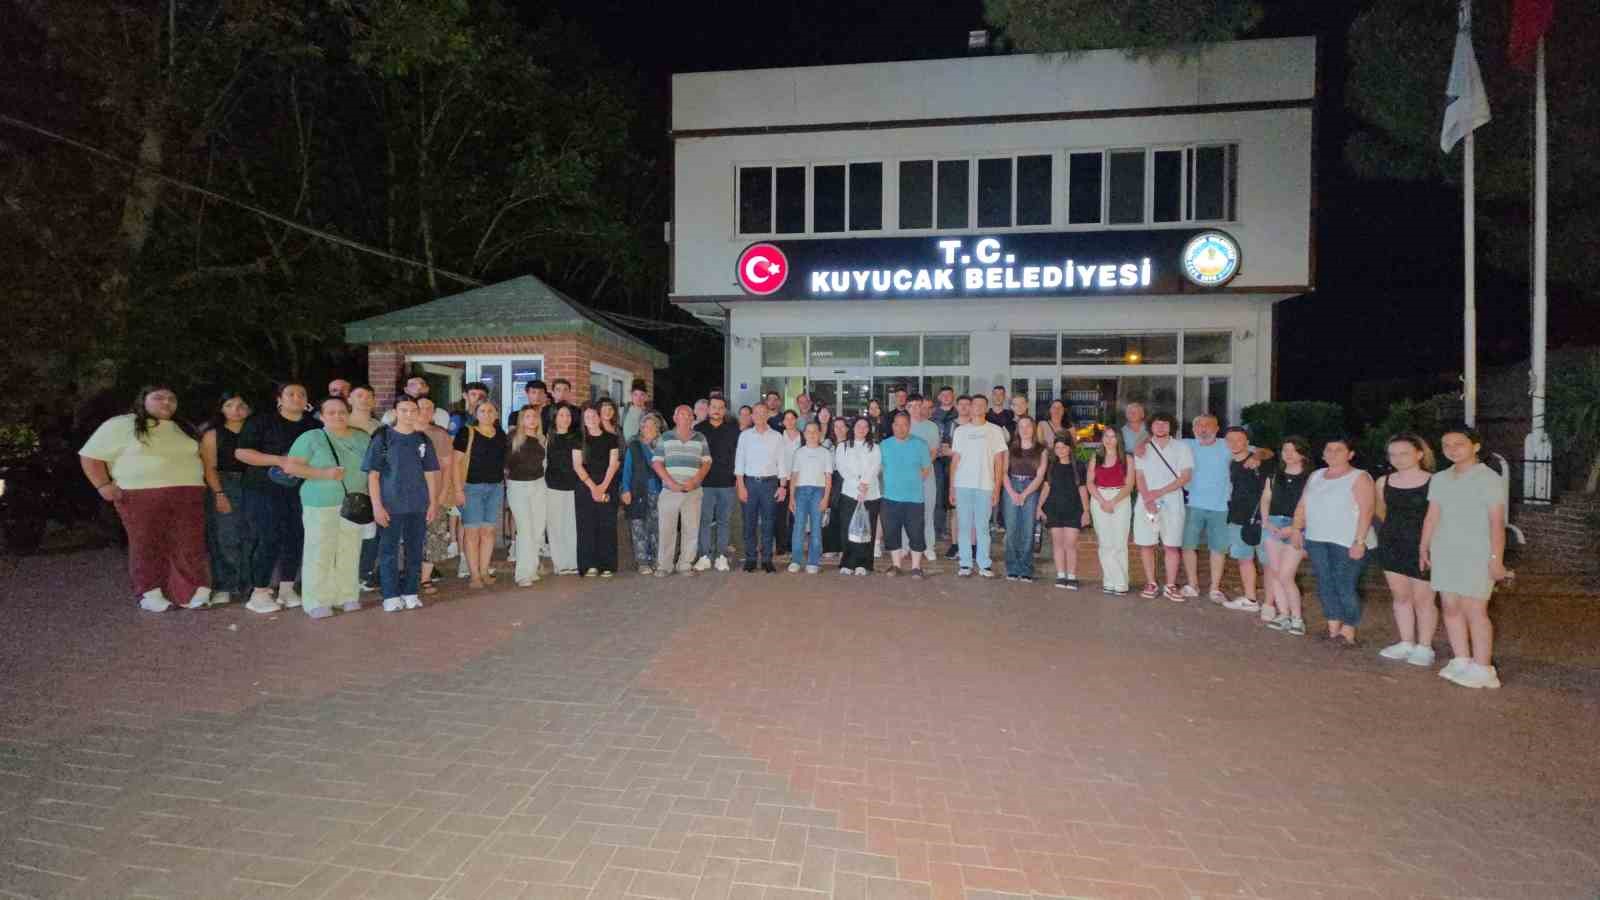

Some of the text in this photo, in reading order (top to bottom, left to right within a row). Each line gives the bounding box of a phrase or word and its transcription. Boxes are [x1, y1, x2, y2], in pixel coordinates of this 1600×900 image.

[938, 238, 1016, 264] T.C.
[810, 267, 955, 293] KUYUCAK
[965, 257, 1152, 290] BELEDİYESİ
